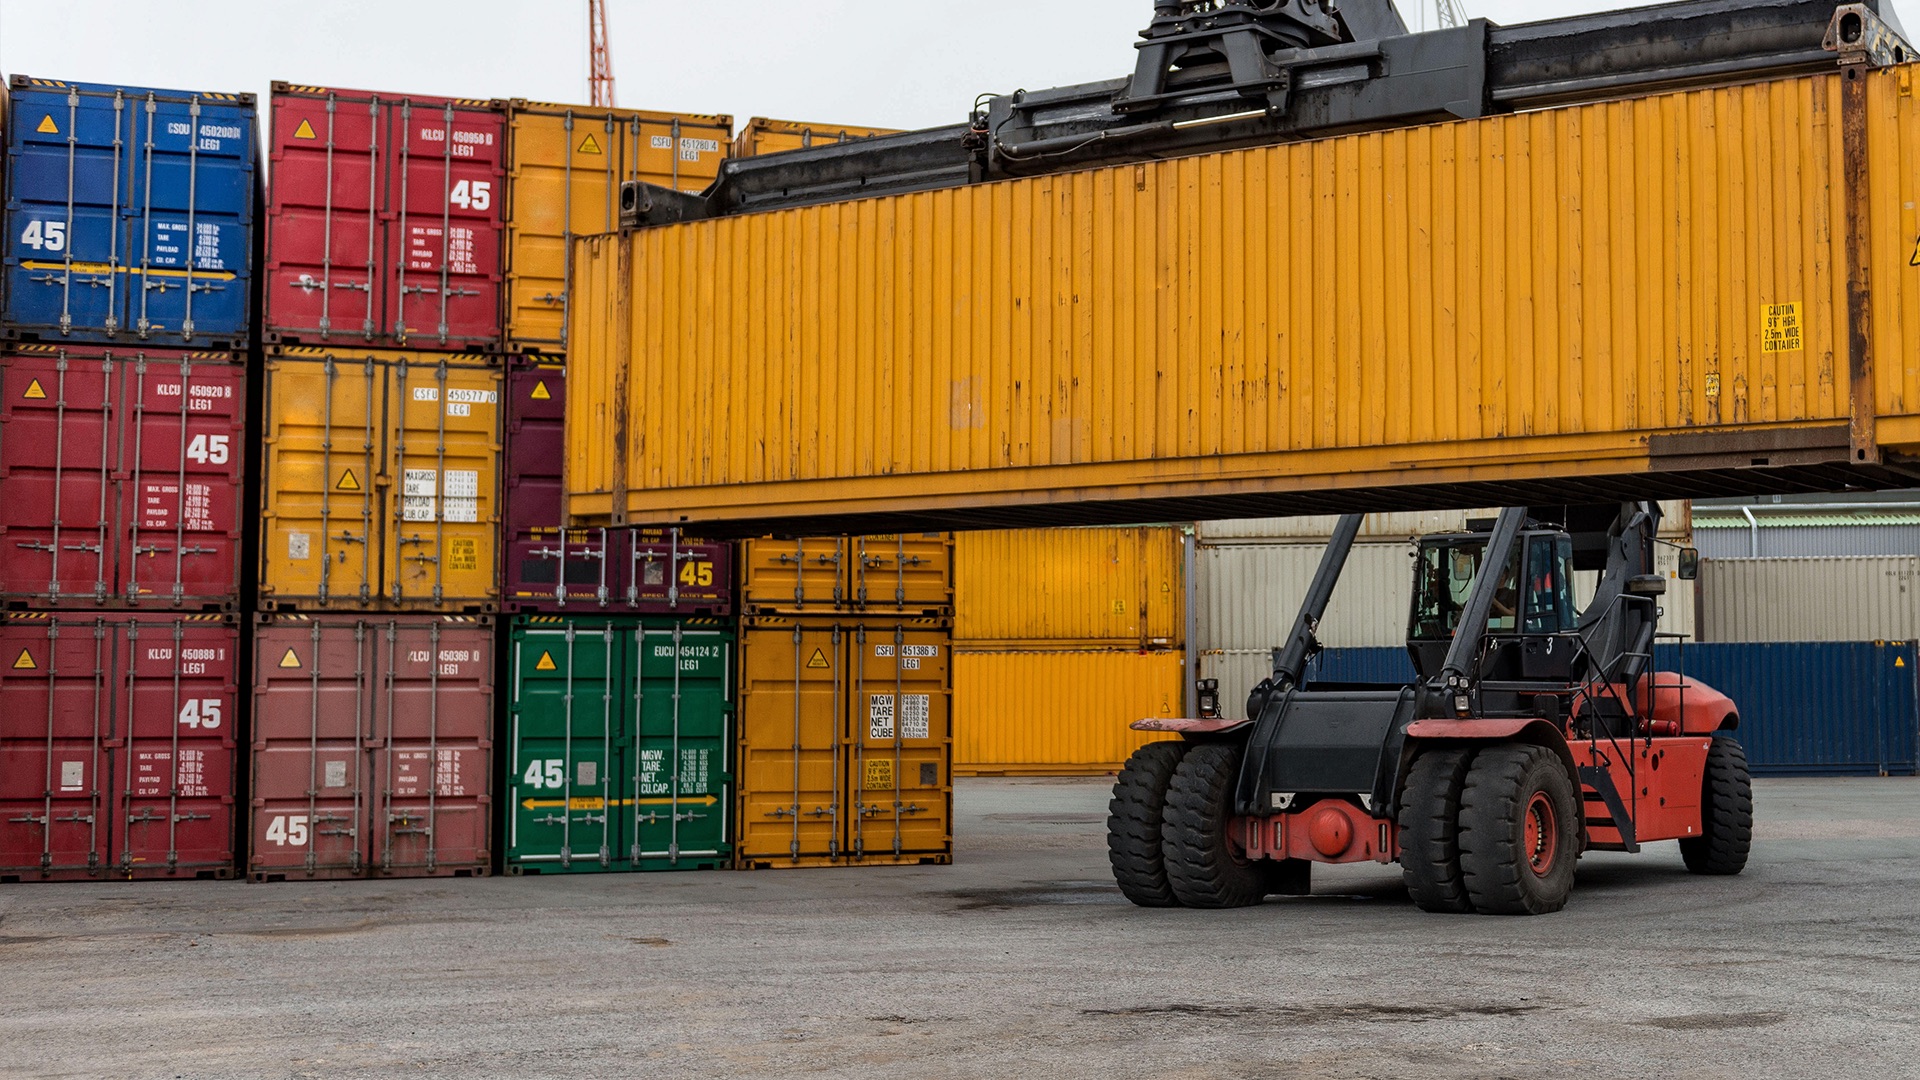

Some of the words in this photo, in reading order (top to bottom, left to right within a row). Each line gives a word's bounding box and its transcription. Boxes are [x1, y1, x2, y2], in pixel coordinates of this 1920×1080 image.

[168, 123, 190, 135] CSOU
[422, 129, 445, 141] KLCU
[453, 131, 484, 144] 450958
[200, 138, 220, 151] LEG1
[653, 137, 671, 147] CSFU
[681, 139, 709, 150] 451280
[711, 141, 717, 151] 4
[453, 144, 474, 157] LEG1
[681, 150, 699, 160] LEG1
[450, 180, 491, 211] 45
[22, 220, 65, 251] 45
[157, 384, 181, 396] KLCU
[190, 385, 223, 398] 450920
[414, 389, 438, 399] CSFU
[449, 390, 483, 401] 450577
[490, 391, 496, 402] 0
[190, 399, 212, 410] LEG1
[448, 404, 470, 415] LEG1
[187, 434, 229, 465] 45
[406, 483, 419, 493] TARE
[405, 496, 430, 507] PAYLOAD
[680, 561, 713, 586] 45
[654, 646, 674, 657] EUCU
[680, 646, 709, 657] 454124
[712, 646, 719, 657] 2
[876, 646, 894, 655] CSFU
[902, 646, 929, 656] 451386
[931, 646, 937, 656] 3
[1546, 637, 1553, 655] 3
[148, 649, 172, 660] KLCU
[182, 649, 215, 660] 450888
[439, 650, 469, 661] 450369
[473, 650, 479, 661] 0
[183, 663, 205, 674] LEG1
[680, 660, 698, 670] LEG1
[902, 659, 919, 668] LEG1
[440, 664, 458, 675] LEG1
[871, 696, 893, 705] MGW
[179, 699, 221, 728] 45
[872, 706, 893, 716] TARE
[871, 717, 889, 726] NET
[871, 727, 893, 737] CUBE
[641, 750, 665, 760] MGW.
[642, 761, 664, 771] TARE.
[524, 759, 563, 789] 45
[641, 772, 659, 782] NET.
[266, 816, 308, 846] 45
